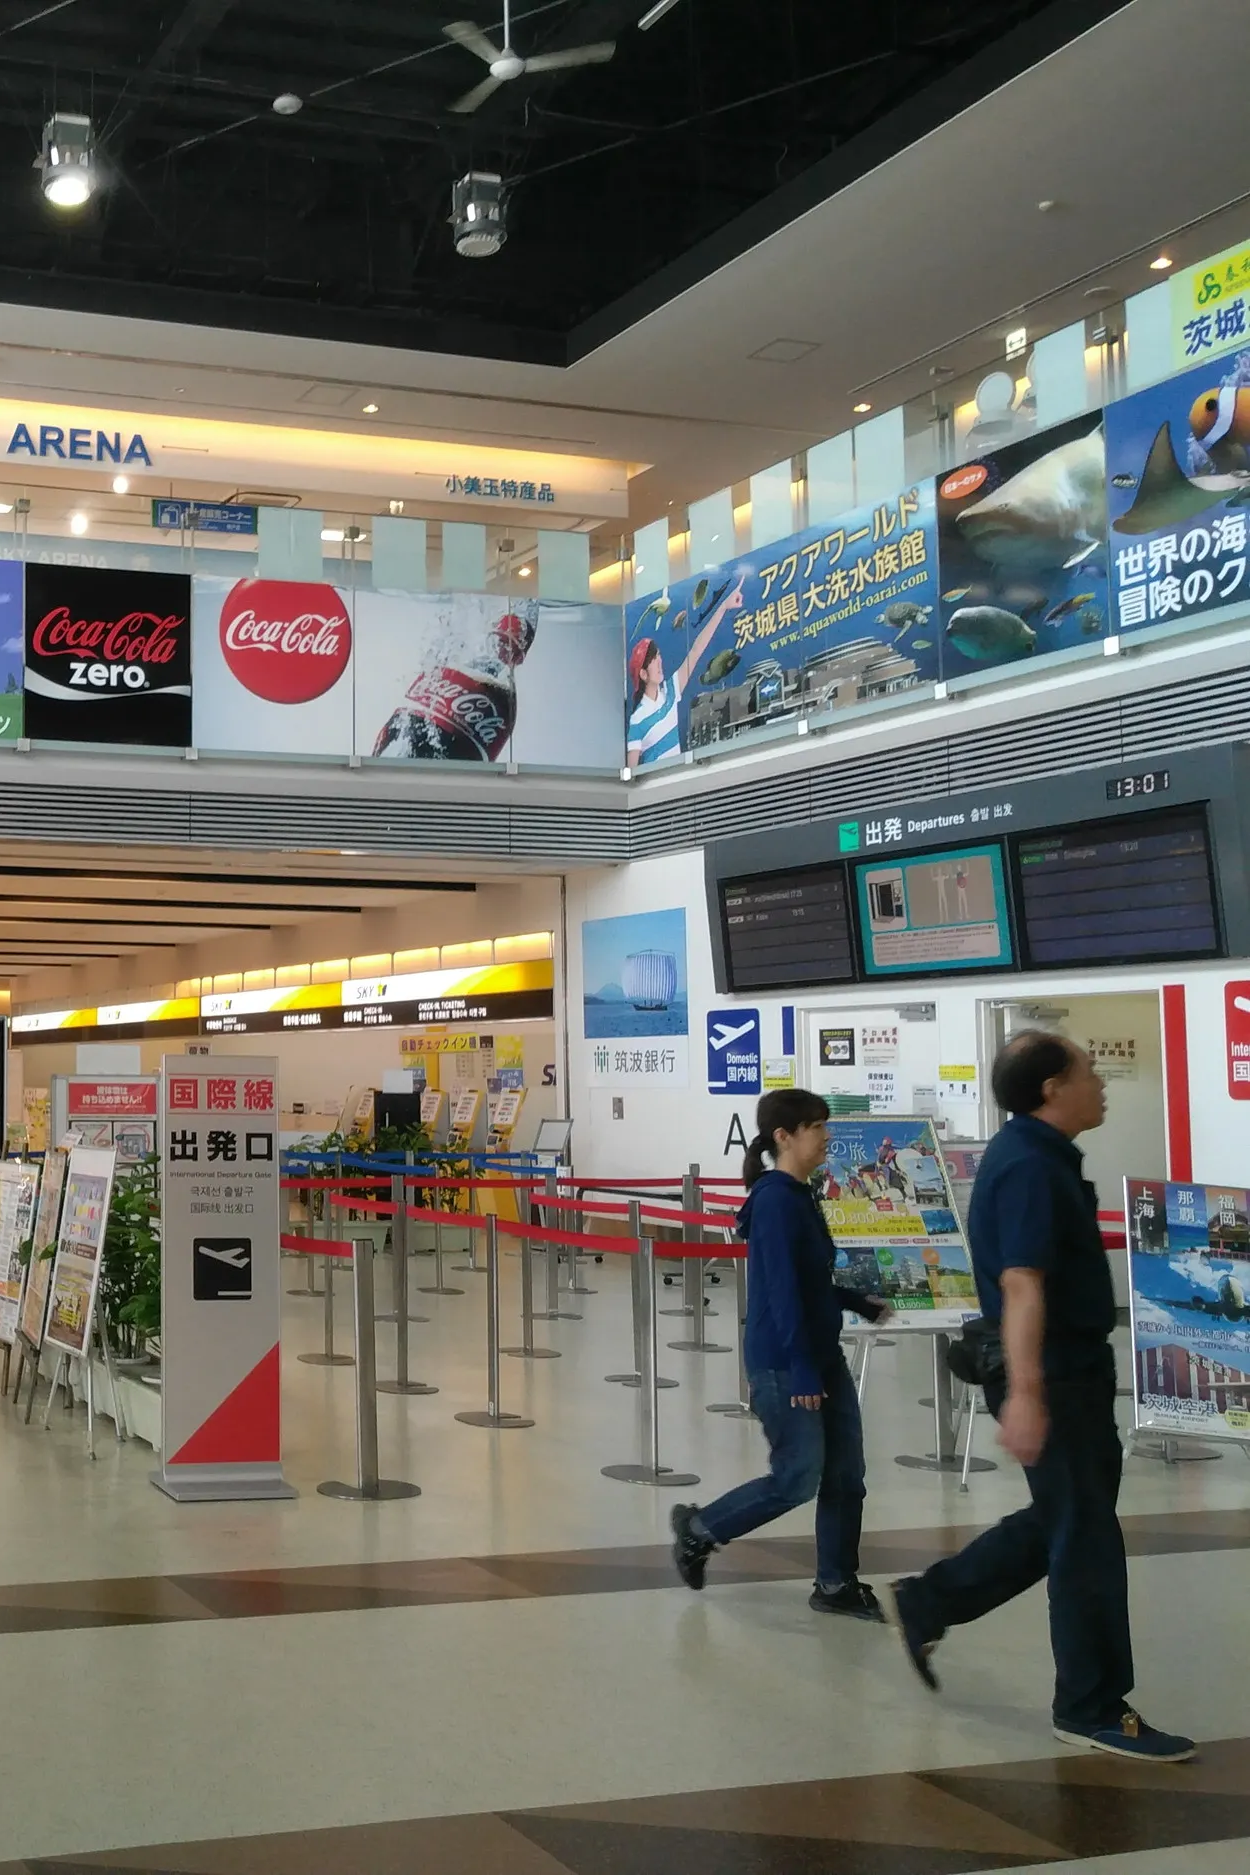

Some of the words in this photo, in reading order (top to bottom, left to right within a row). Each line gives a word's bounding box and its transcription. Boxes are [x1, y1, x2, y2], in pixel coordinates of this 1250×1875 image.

[1182, 298, 1250, 356] 茨城
[7, 422, 152, 467] ARENA
[445, 473, 555, 502] 小美玉特産品
[758, 487, 920, 600] アクアワールド
[1115, 512, 1250, 587] 世界の海
[1118, 556, 1250, 628] 冒険のク
[32, 605, 186, 663] Coca-Cola
[225, 610, 346, 659] Coca-Cola
[68, 659, 146, 690] zero
[1116, 772, 1169, 798] 13:01
[865, 817, 903, 847] 出発
[907, 811, 965, 834] Departures
[356, 985, 375, 1000] SKY
[401, 1034, 478, 1052] 自動チェックイン機
[726, 1052, 759, 1065] Domestic
[542, 1063, 556, 1087] S
[614, 1049, 676, 1074] 筑波銀行
[726, 1066, 759, 1082] 国内線
[1232, 1060, 1250, 1082] 国
[169, 1078, 275, 1110] 国際線
[169, 1129, 274, 1162] 出発口
[217, 1171, 252, 1179] Departure
[255, 1171, 272, 1179] Gate
[1137, 1186, 1155, 1219] 上海
[1177, 1190, 1195, 1222] 那覇
[1218, 1194, 1236, 1227] 福岡
[1142, 1392, 1218, 1417] 茨城空港
